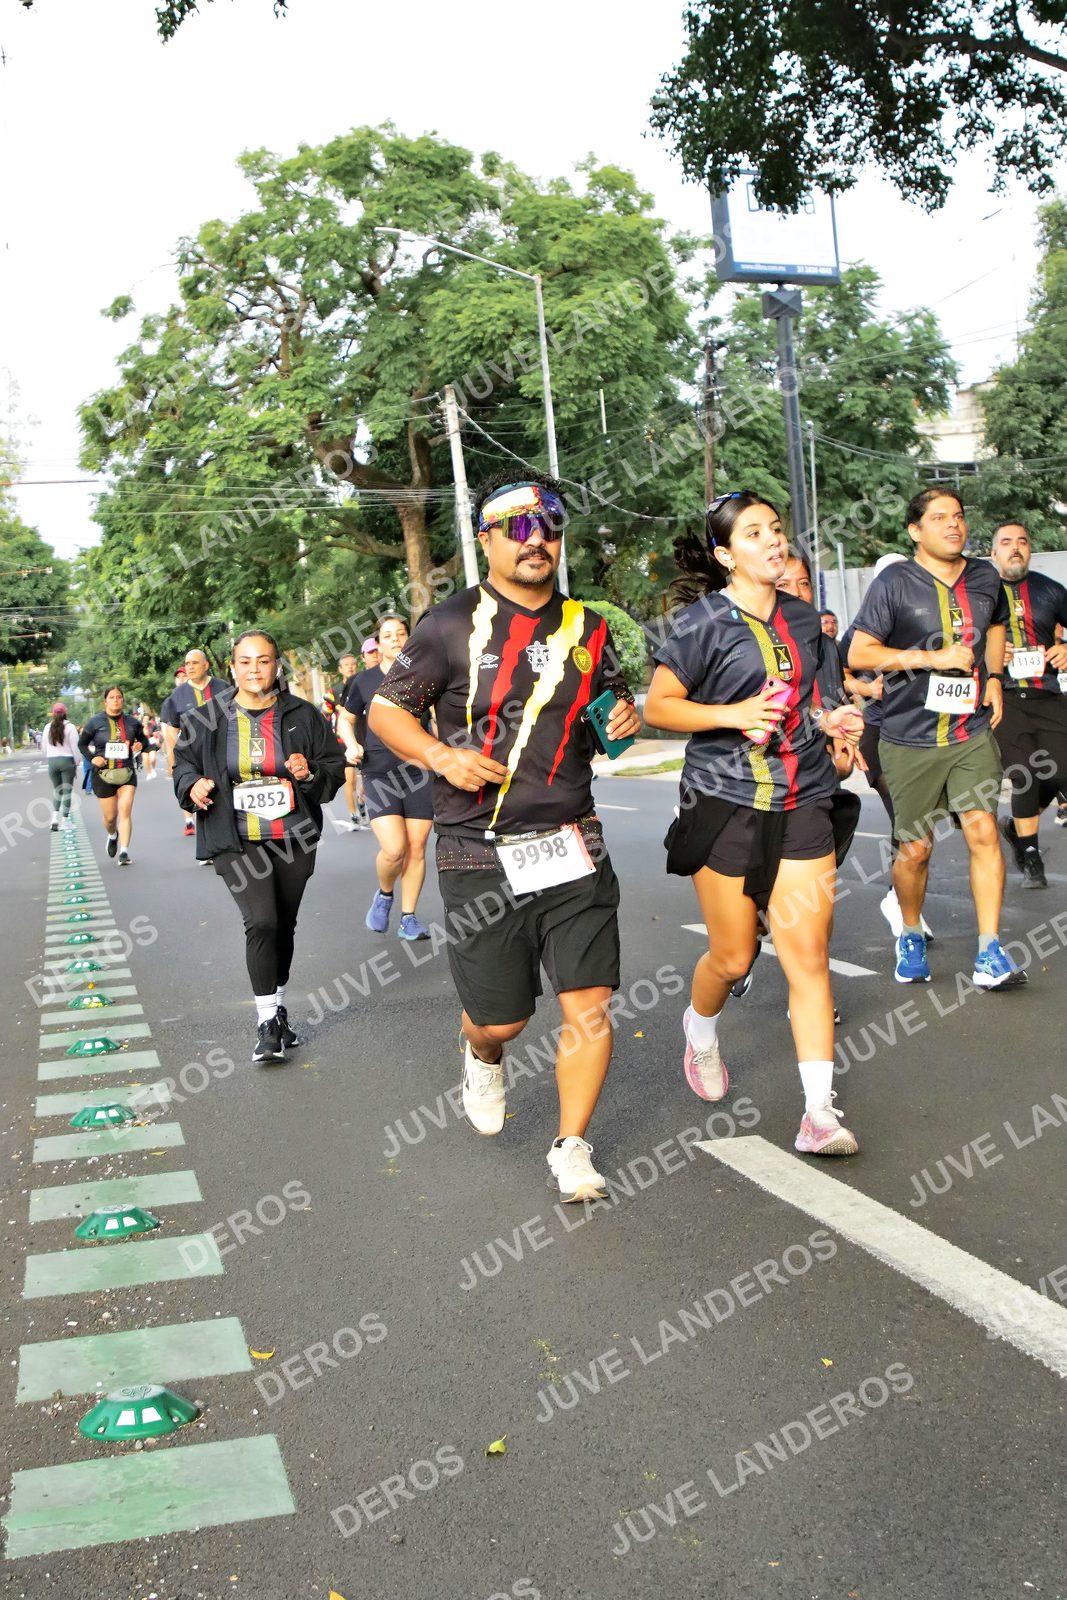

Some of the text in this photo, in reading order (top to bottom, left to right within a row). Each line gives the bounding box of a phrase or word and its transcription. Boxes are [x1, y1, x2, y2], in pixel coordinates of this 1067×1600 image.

[936, 683, 971, 697] 8404
[238, 791, 286, 809] 12852
[511, 836, 568, 869] 9998
